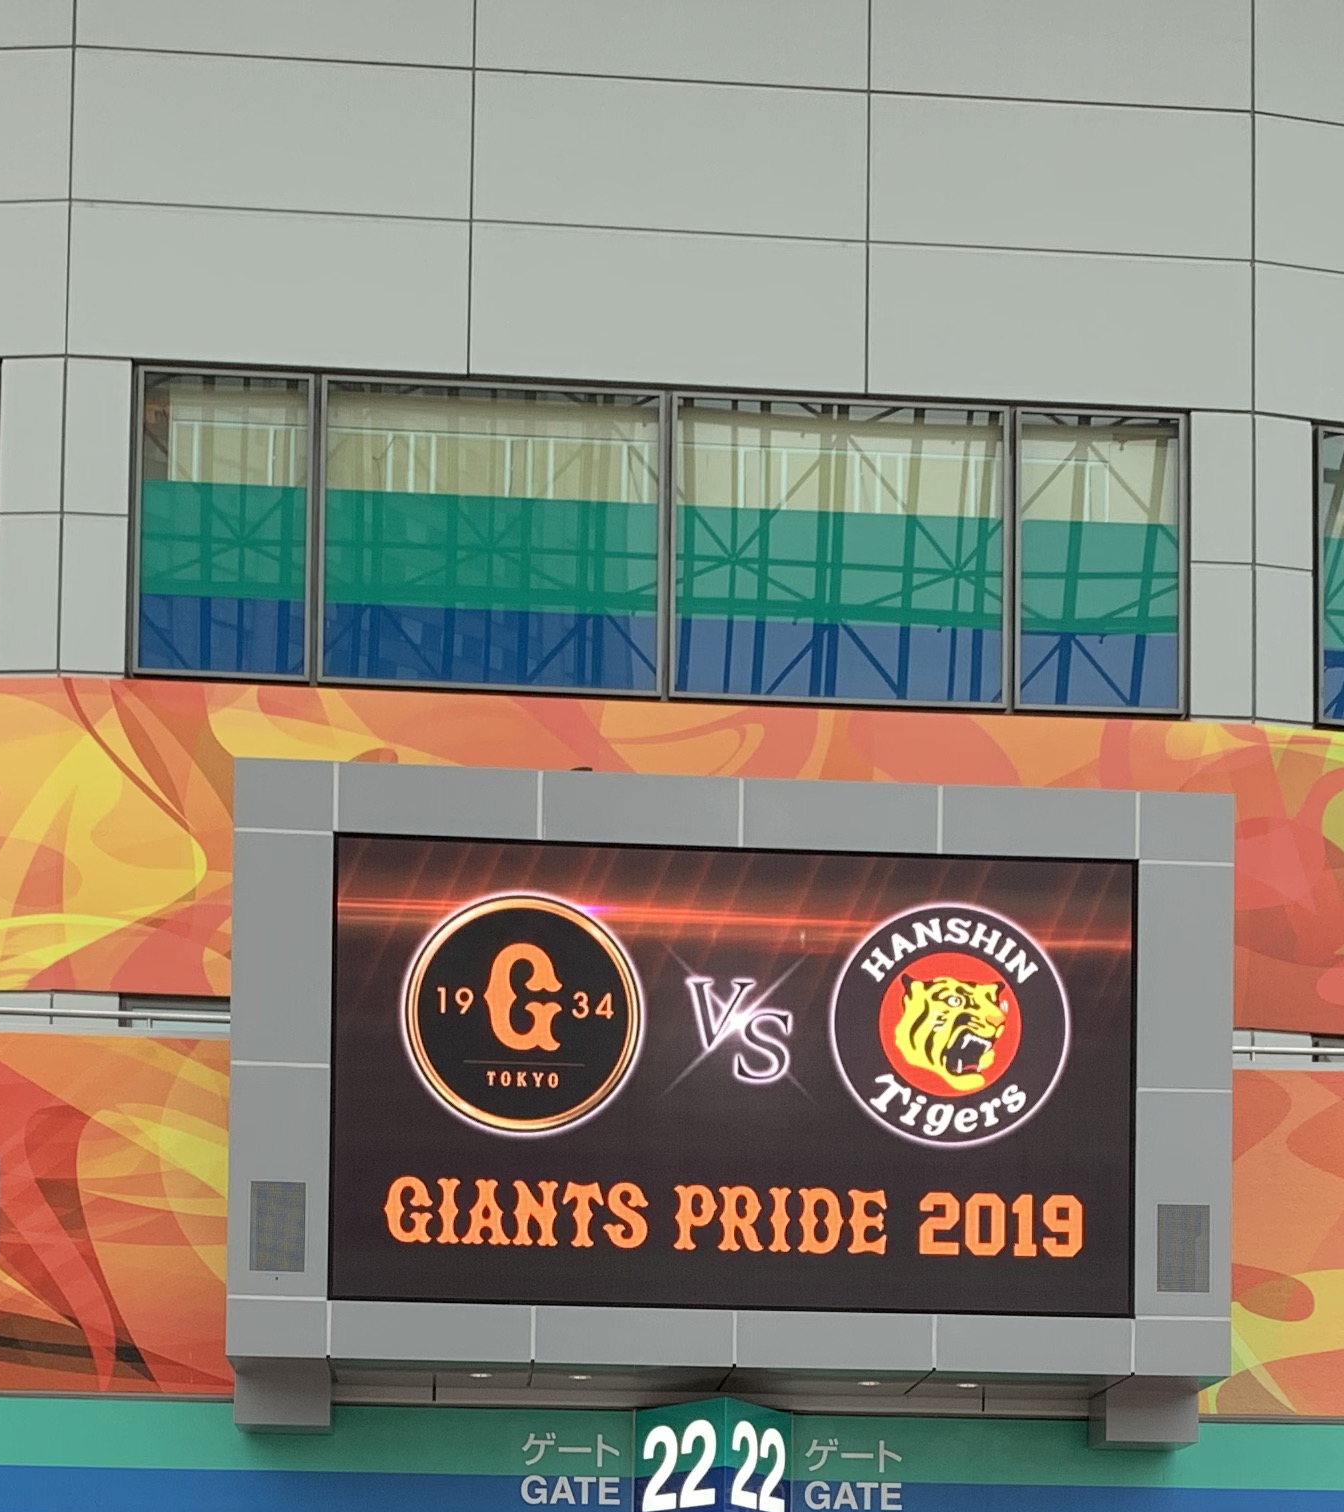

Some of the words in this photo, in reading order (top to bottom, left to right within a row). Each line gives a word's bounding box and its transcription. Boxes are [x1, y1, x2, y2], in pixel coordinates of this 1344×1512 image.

[860, 916, 1040, 984] HANSHIN
[437, 986, 474, 1016] 19
[483, 943, 563, 1052] G
[571, 991, 614, 1020] 34
[685, 975, 791, 1083] VS
[486, 1069, 560, 1089] TOKYO
[869, 1072, 1029, 1137] Tigers
[384, 1175, 648, 1250] GIANTS
[673, 1183, 889, 1256] PRIDE
[918, 1191, 1084, 1259] 2019
[521, 1431, 620, 1468] ゲート
[641, 1419, 717, 1512] 22
[804, 1438, 903, 1474] ゲート
[520, 1475, 621, 1506] GATE
[804, 1480, 903, 1511] GATE
